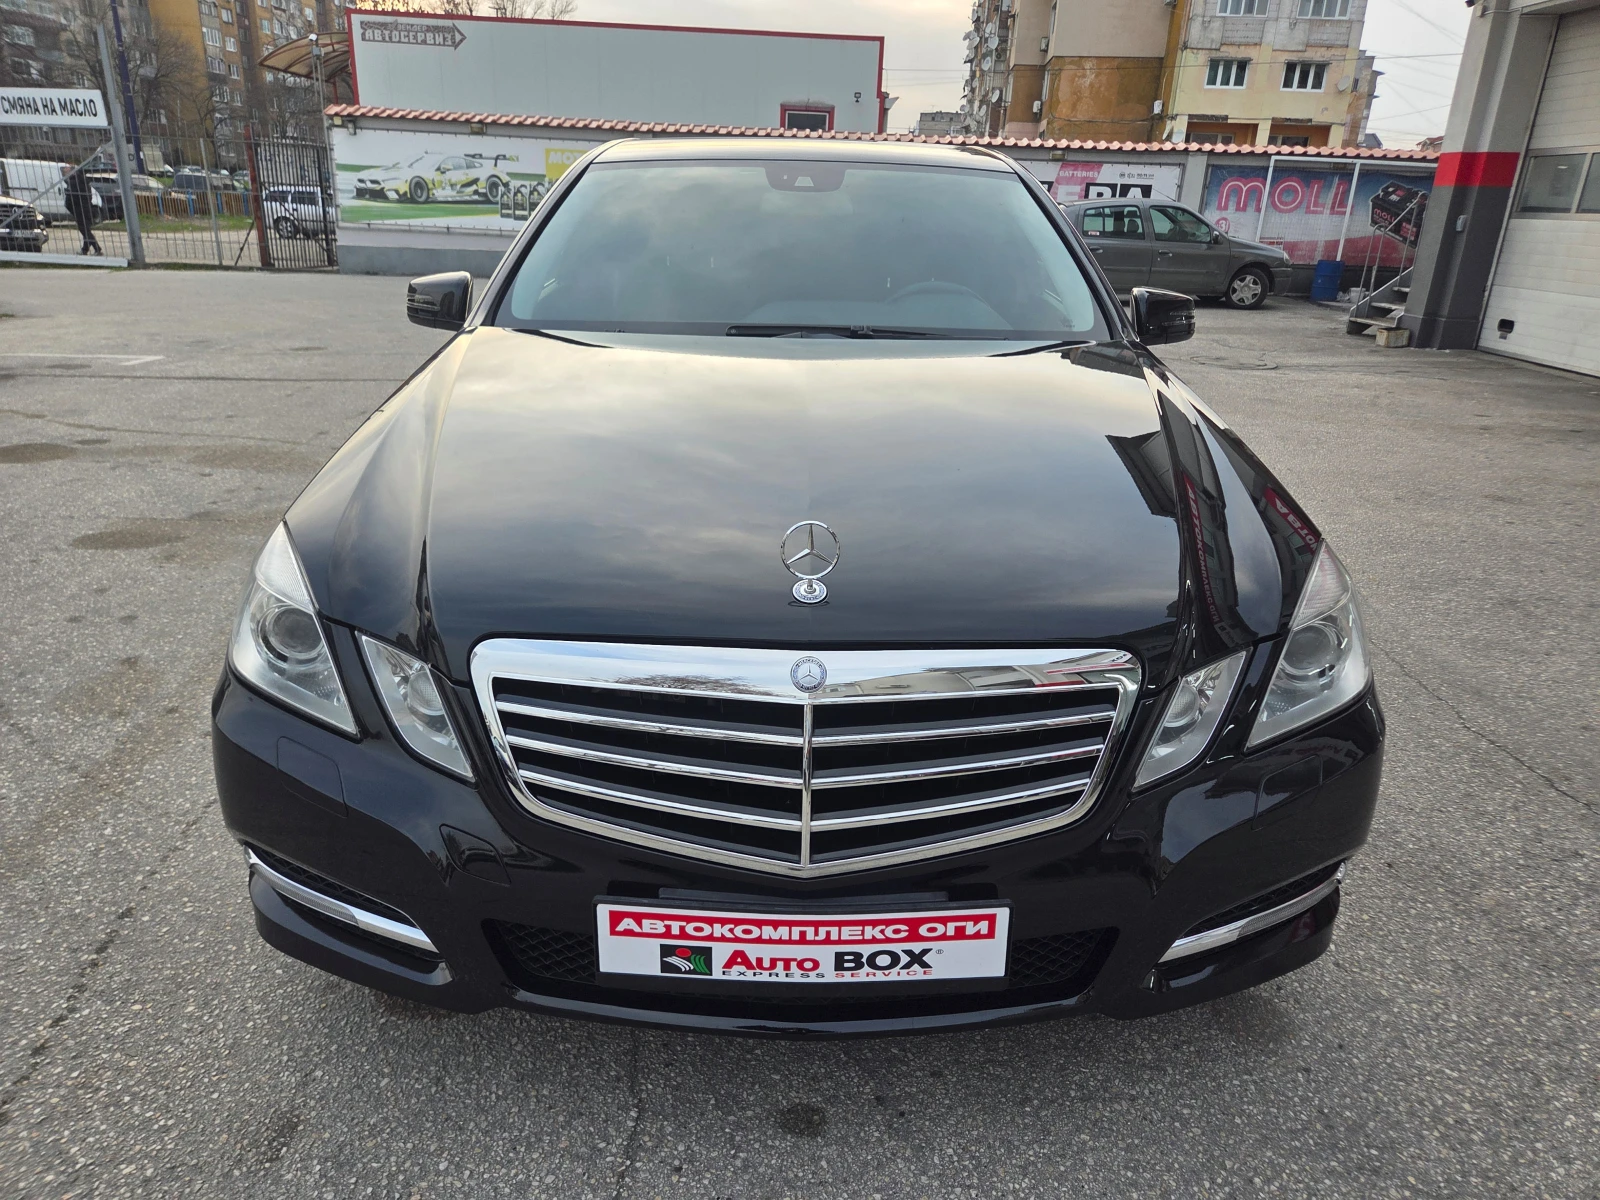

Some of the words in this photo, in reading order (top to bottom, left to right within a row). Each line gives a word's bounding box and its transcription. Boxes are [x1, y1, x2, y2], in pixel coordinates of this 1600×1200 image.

[364, 29, 452, 45] АВТОСЕРВИЗ
[1, 95, 41, 116] СМЯНА
[40, 97, 58, 116] НА
[57, 97, 98, 118] МАСЛО
[1059, 170, 1098, 178] BATTERIES
[615, 917, 909, 941] АВТОКОМПЛЕКС
[918, 920, 989, 938] ОГИ
[722, 970, 825, 979] EXPRESS
[835, 969, 933, 979] SERVICE
